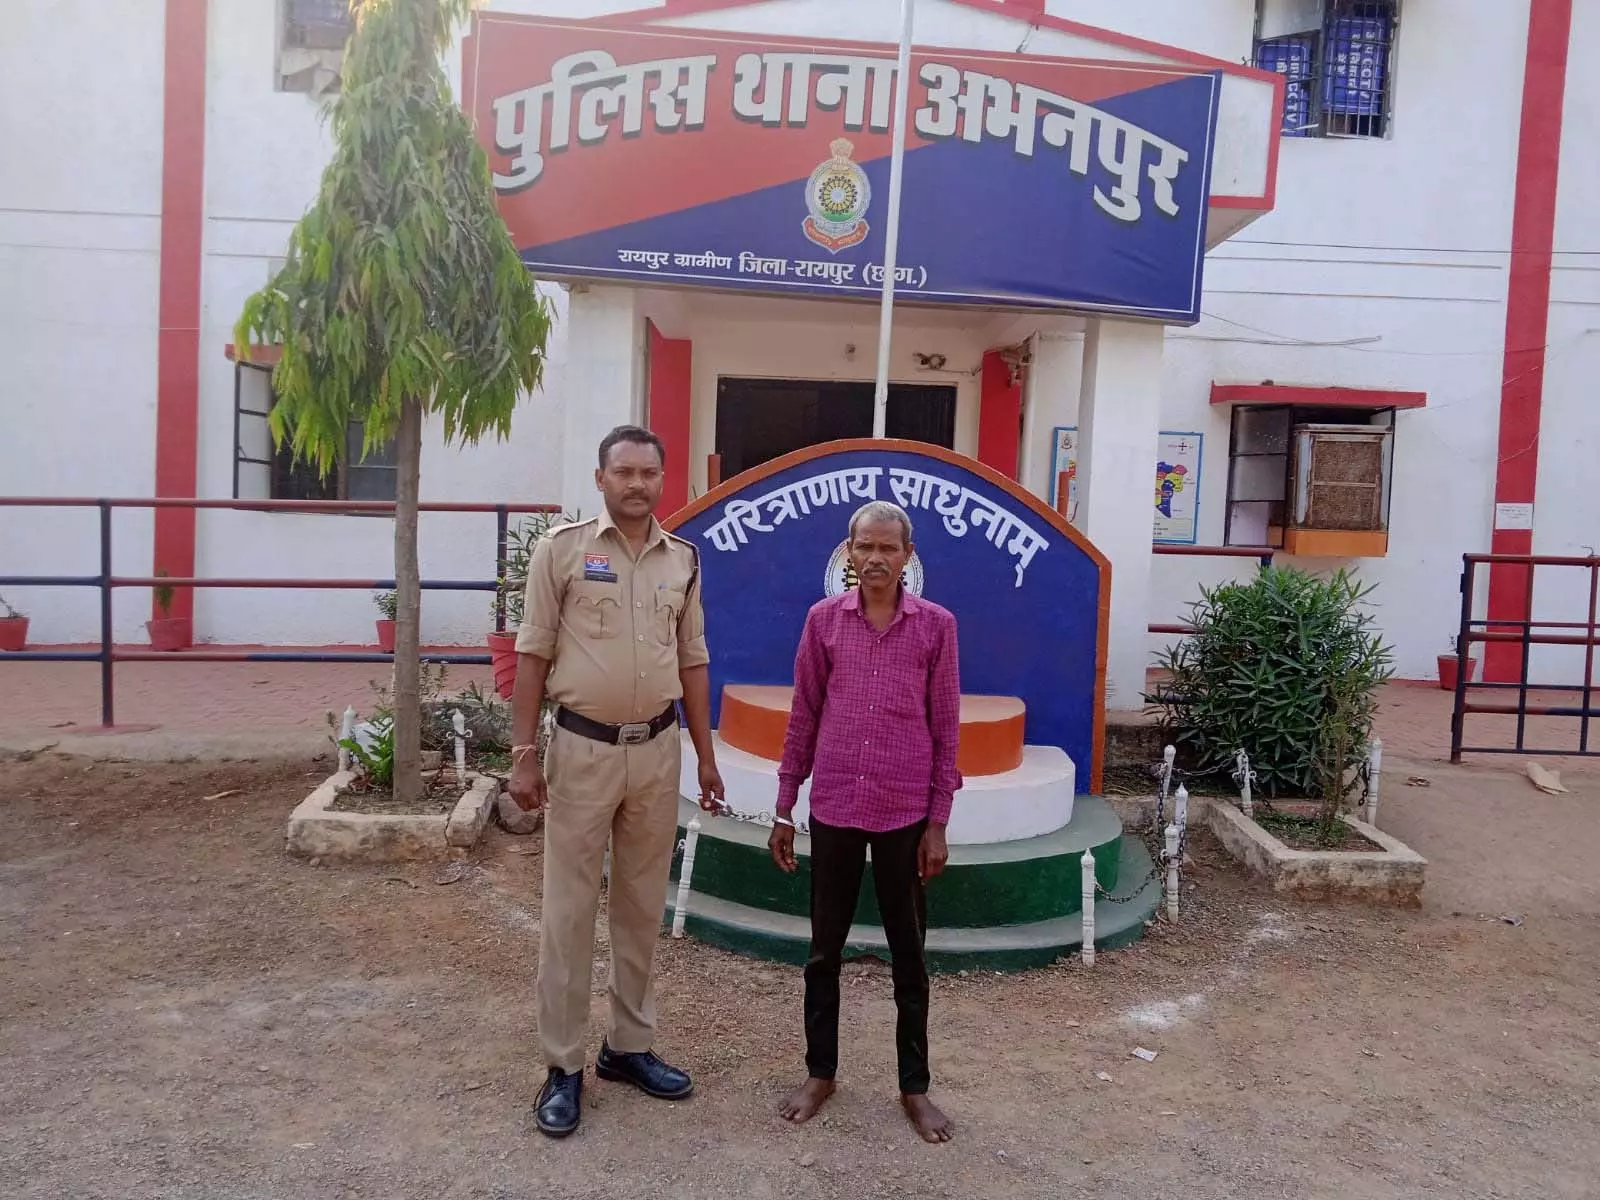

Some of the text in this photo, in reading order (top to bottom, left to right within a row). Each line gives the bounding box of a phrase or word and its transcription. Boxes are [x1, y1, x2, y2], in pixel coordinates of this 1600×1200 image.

[493, 49, 1189, 222] पुलिस थाना अभनपुर
[618, 249, 670, 269] रायपुर
[674, 250, 733, 270] ग्रामीण
[738, 251, 857, 285] जिला-रायपुर
[703, 467, 1050, 588] परित्राणाय साधुनाम्
